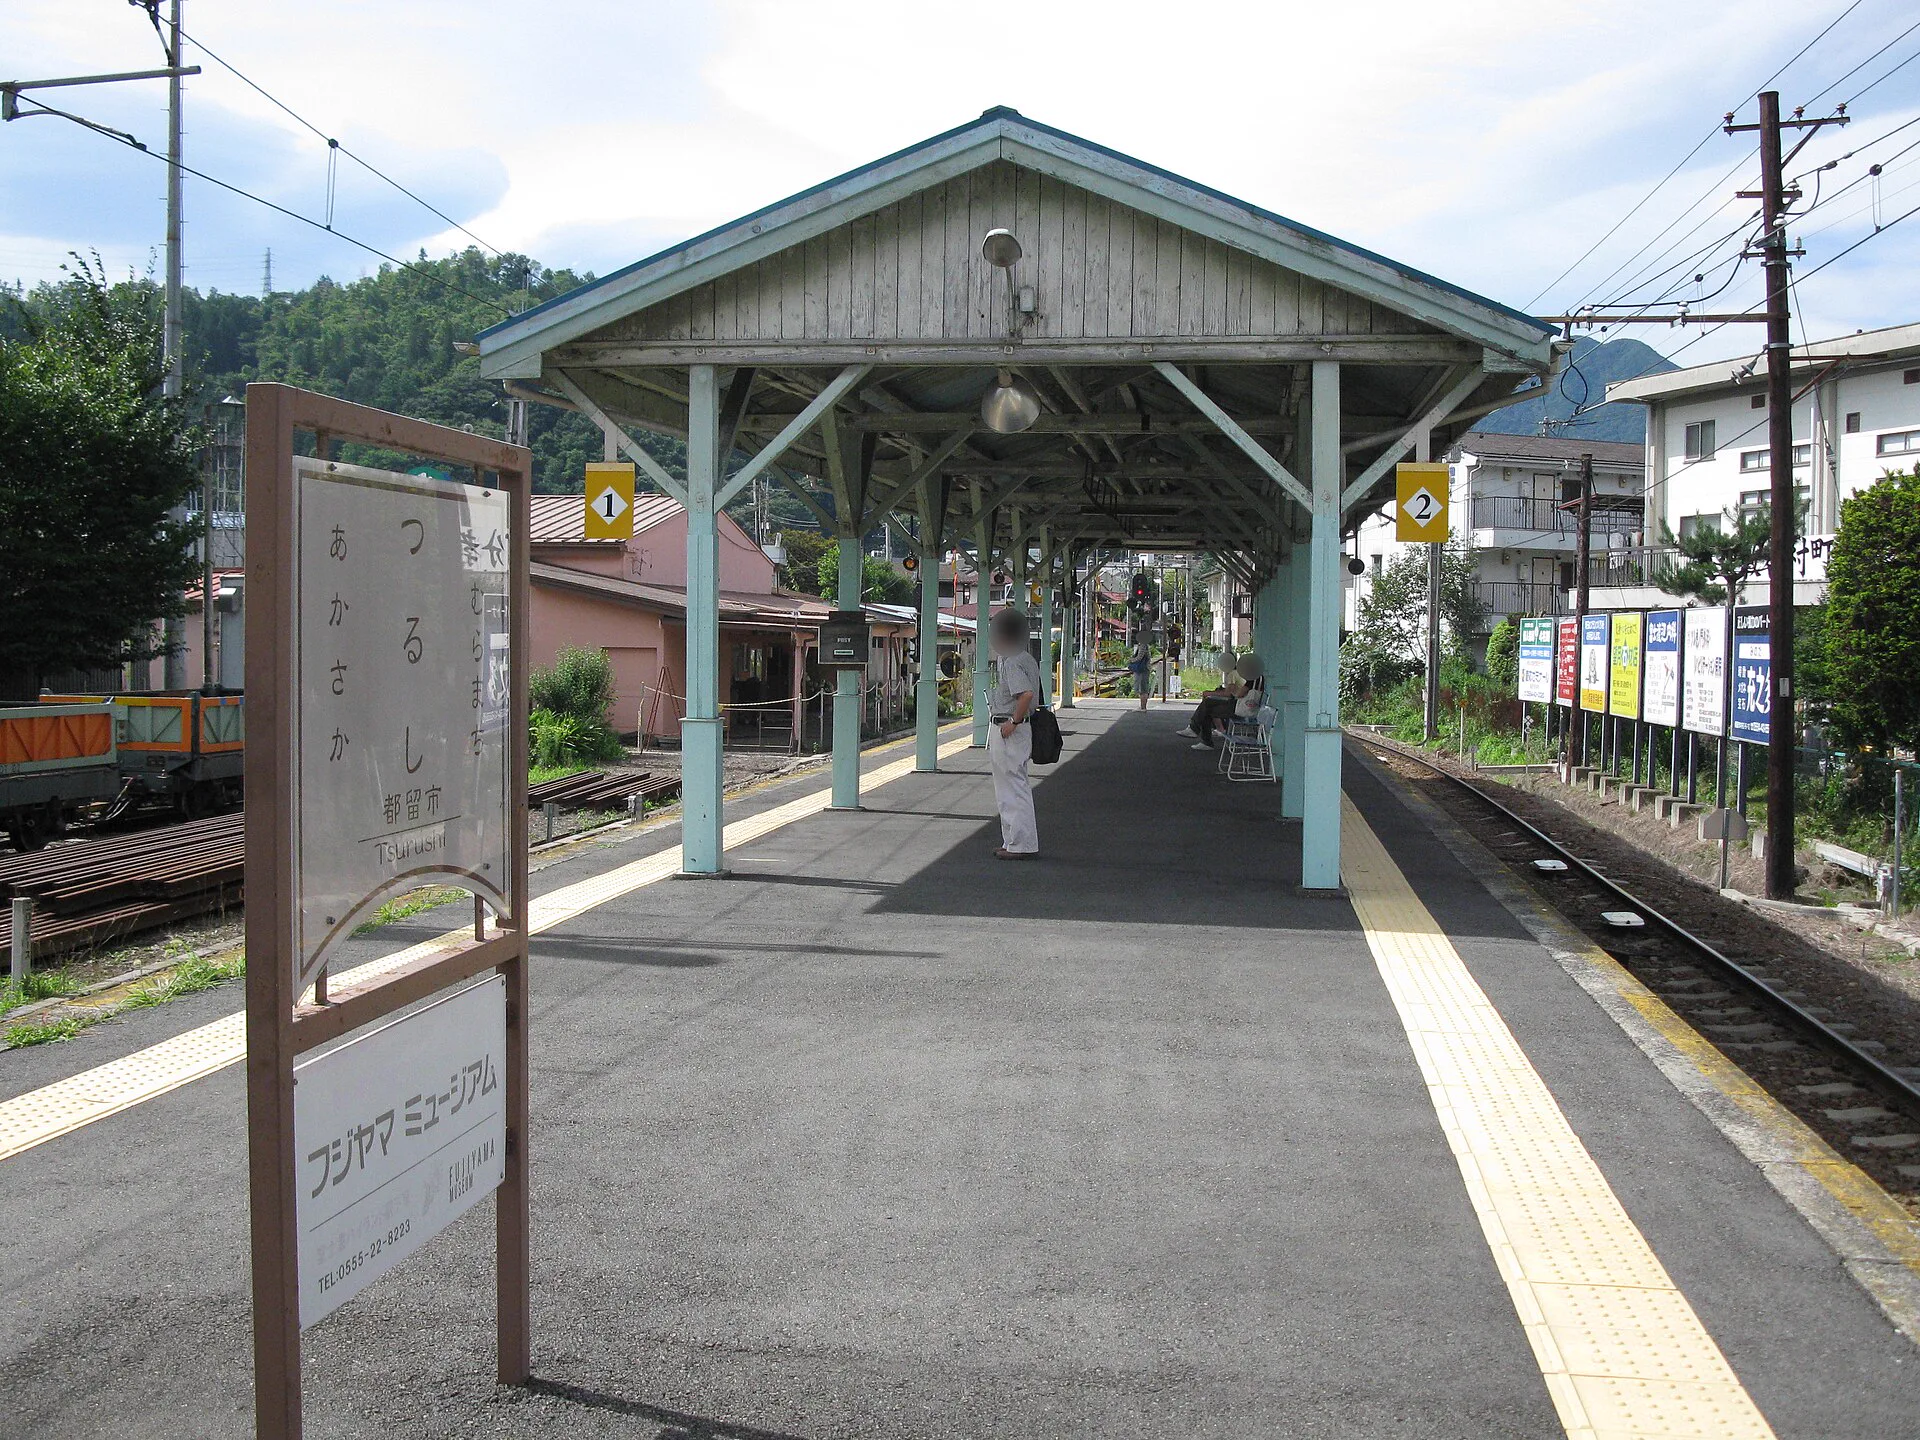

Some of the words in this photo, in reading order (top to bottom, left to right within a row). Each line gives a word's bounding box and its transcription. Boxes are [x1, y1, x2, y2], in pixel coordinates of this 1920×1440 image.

[603, 493, 615, 517] 1
[1415, 494, 1432, 519] 2
[328, 523, 350, 762] あかさか
[401, 518, 425, 774] つるし
[382, 784, 442, 825] 都留市
[374, 829, 447, 865] Tsurushi
[307, 1108, 395, 1199] フジヤマ
[404, 1053, 497, 1137] ミュージアム
[449, 1137, 495, 1185] FUJIYAMA
[449, 1172, 474, 1203] MUSEUM
